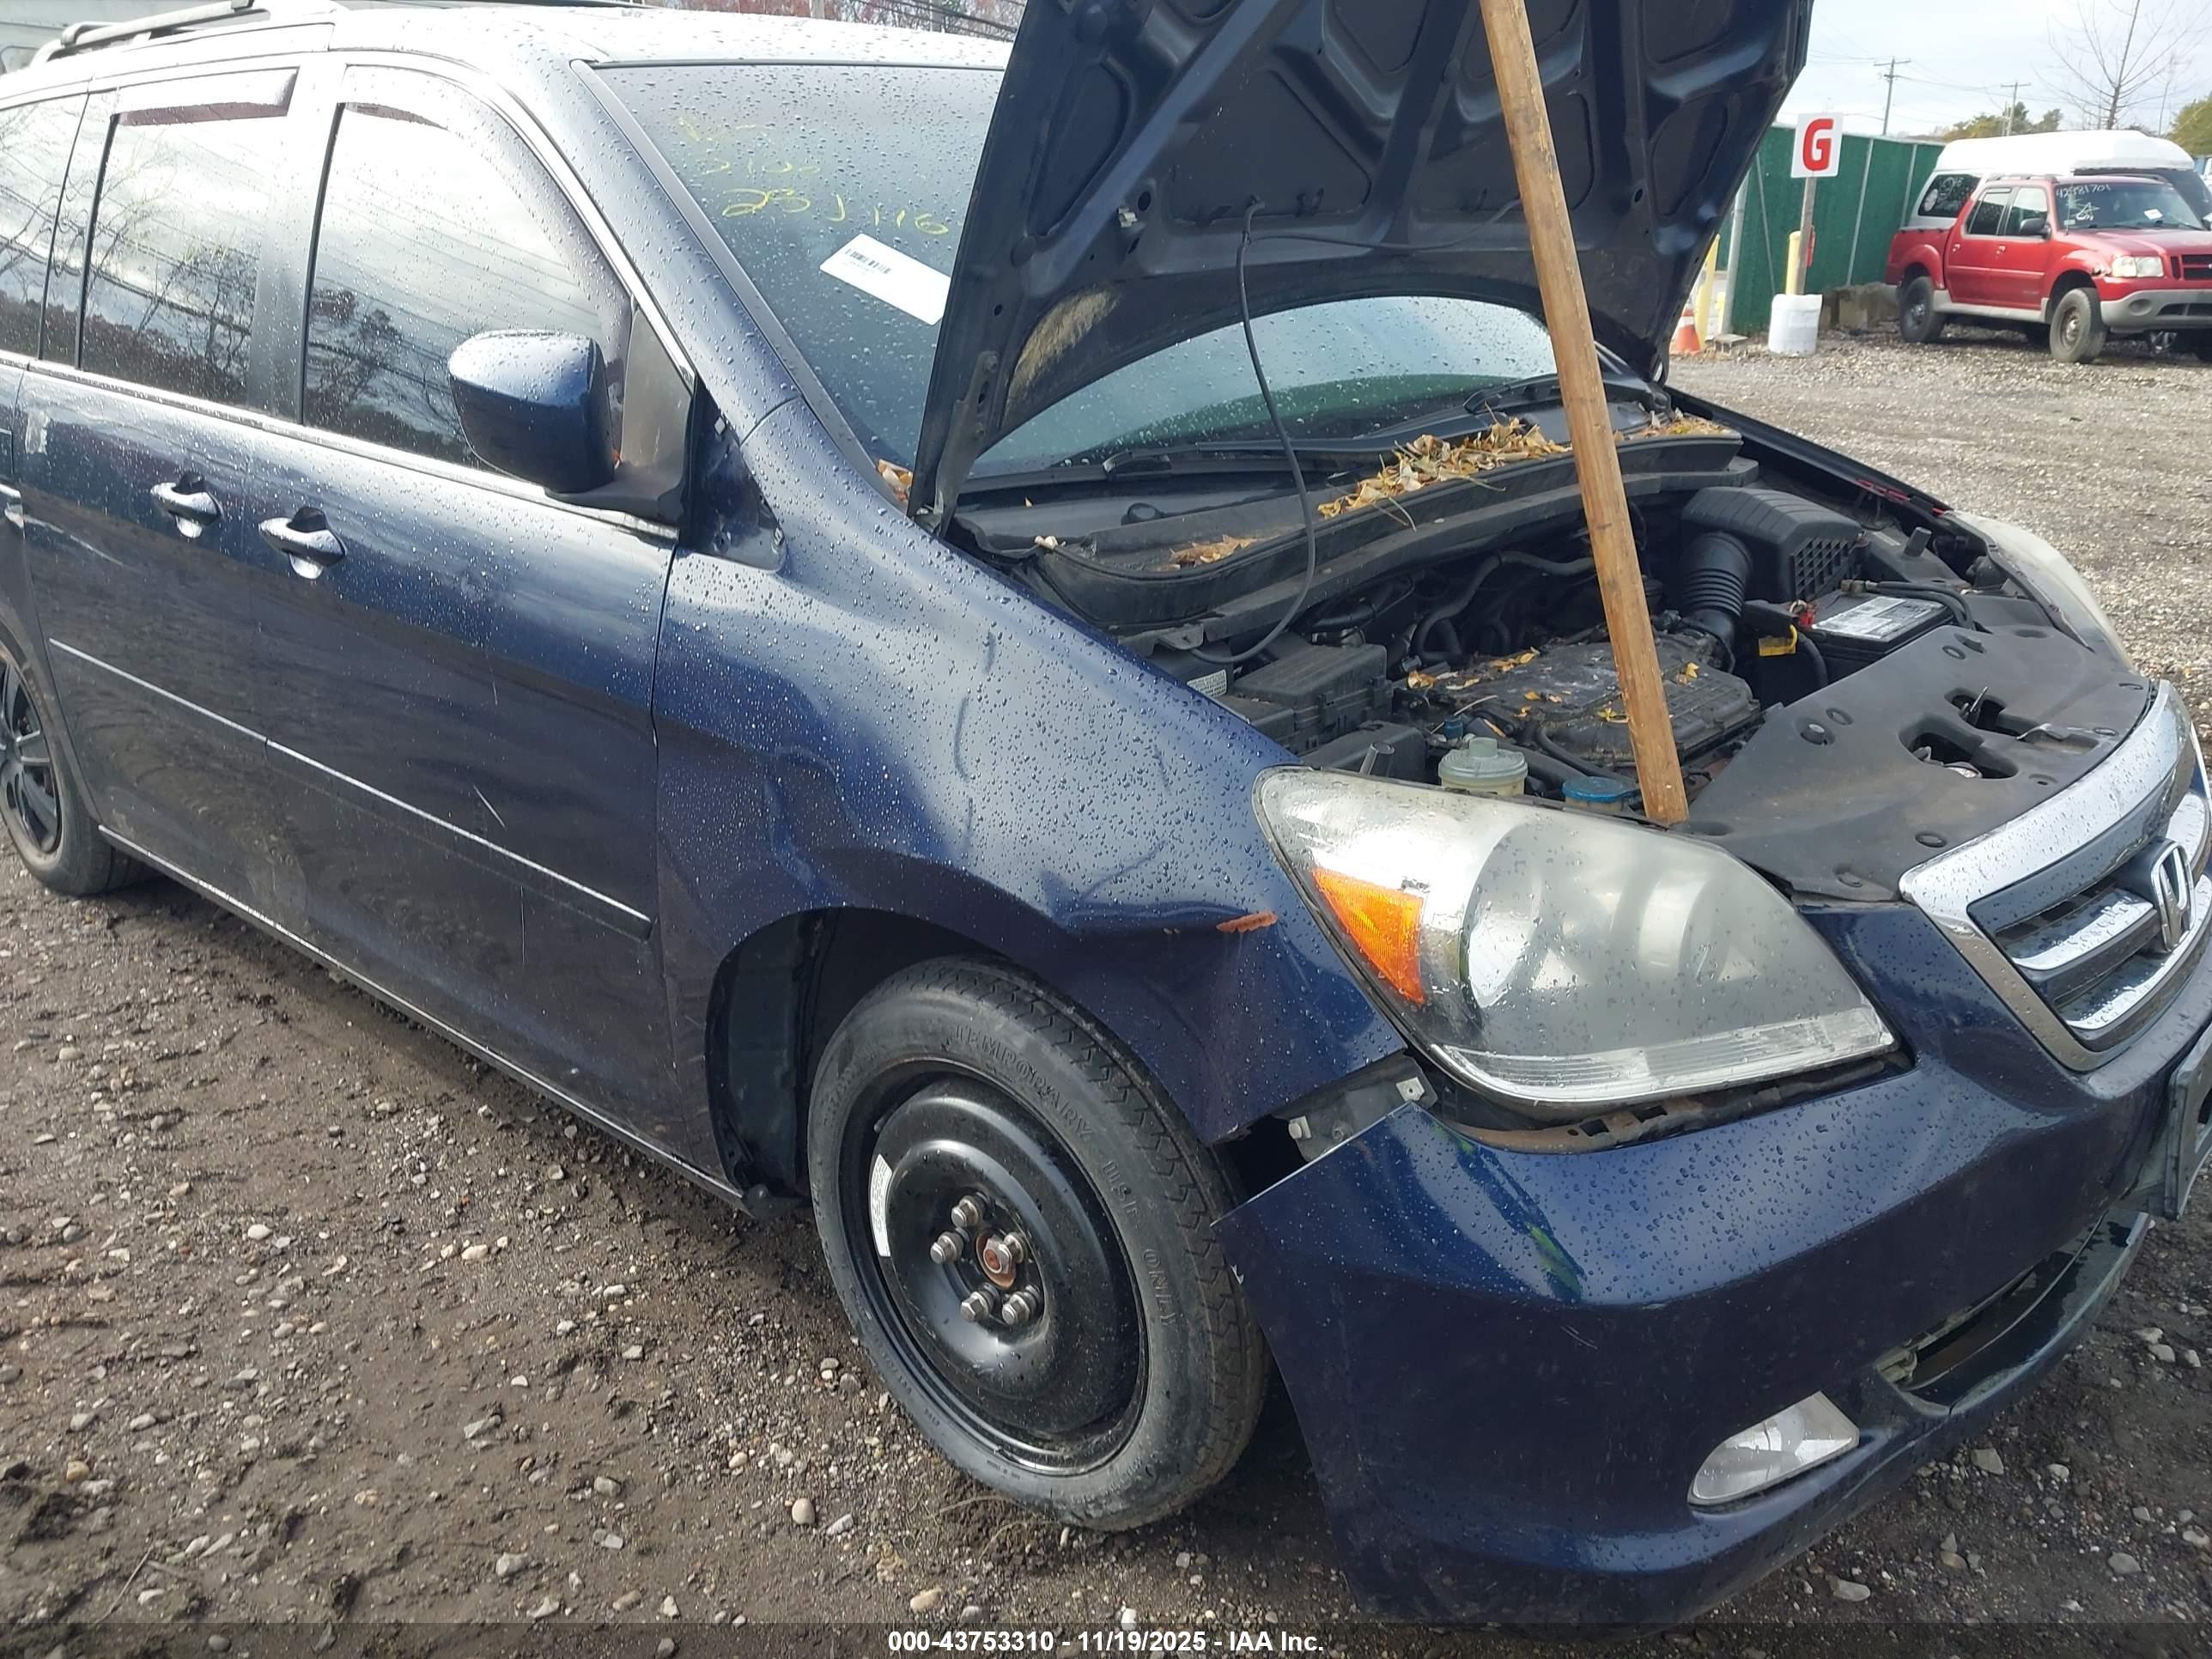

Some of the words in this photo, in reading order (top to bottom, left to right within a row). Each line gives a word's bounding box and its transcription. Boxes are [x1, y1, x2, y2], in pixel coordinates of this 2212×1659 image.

[1802, 118, 1834, 172] G
[954, 1024, 1093, 1136] TEMPORARY
[1141, 1248, 1176, 1327] ONLY
